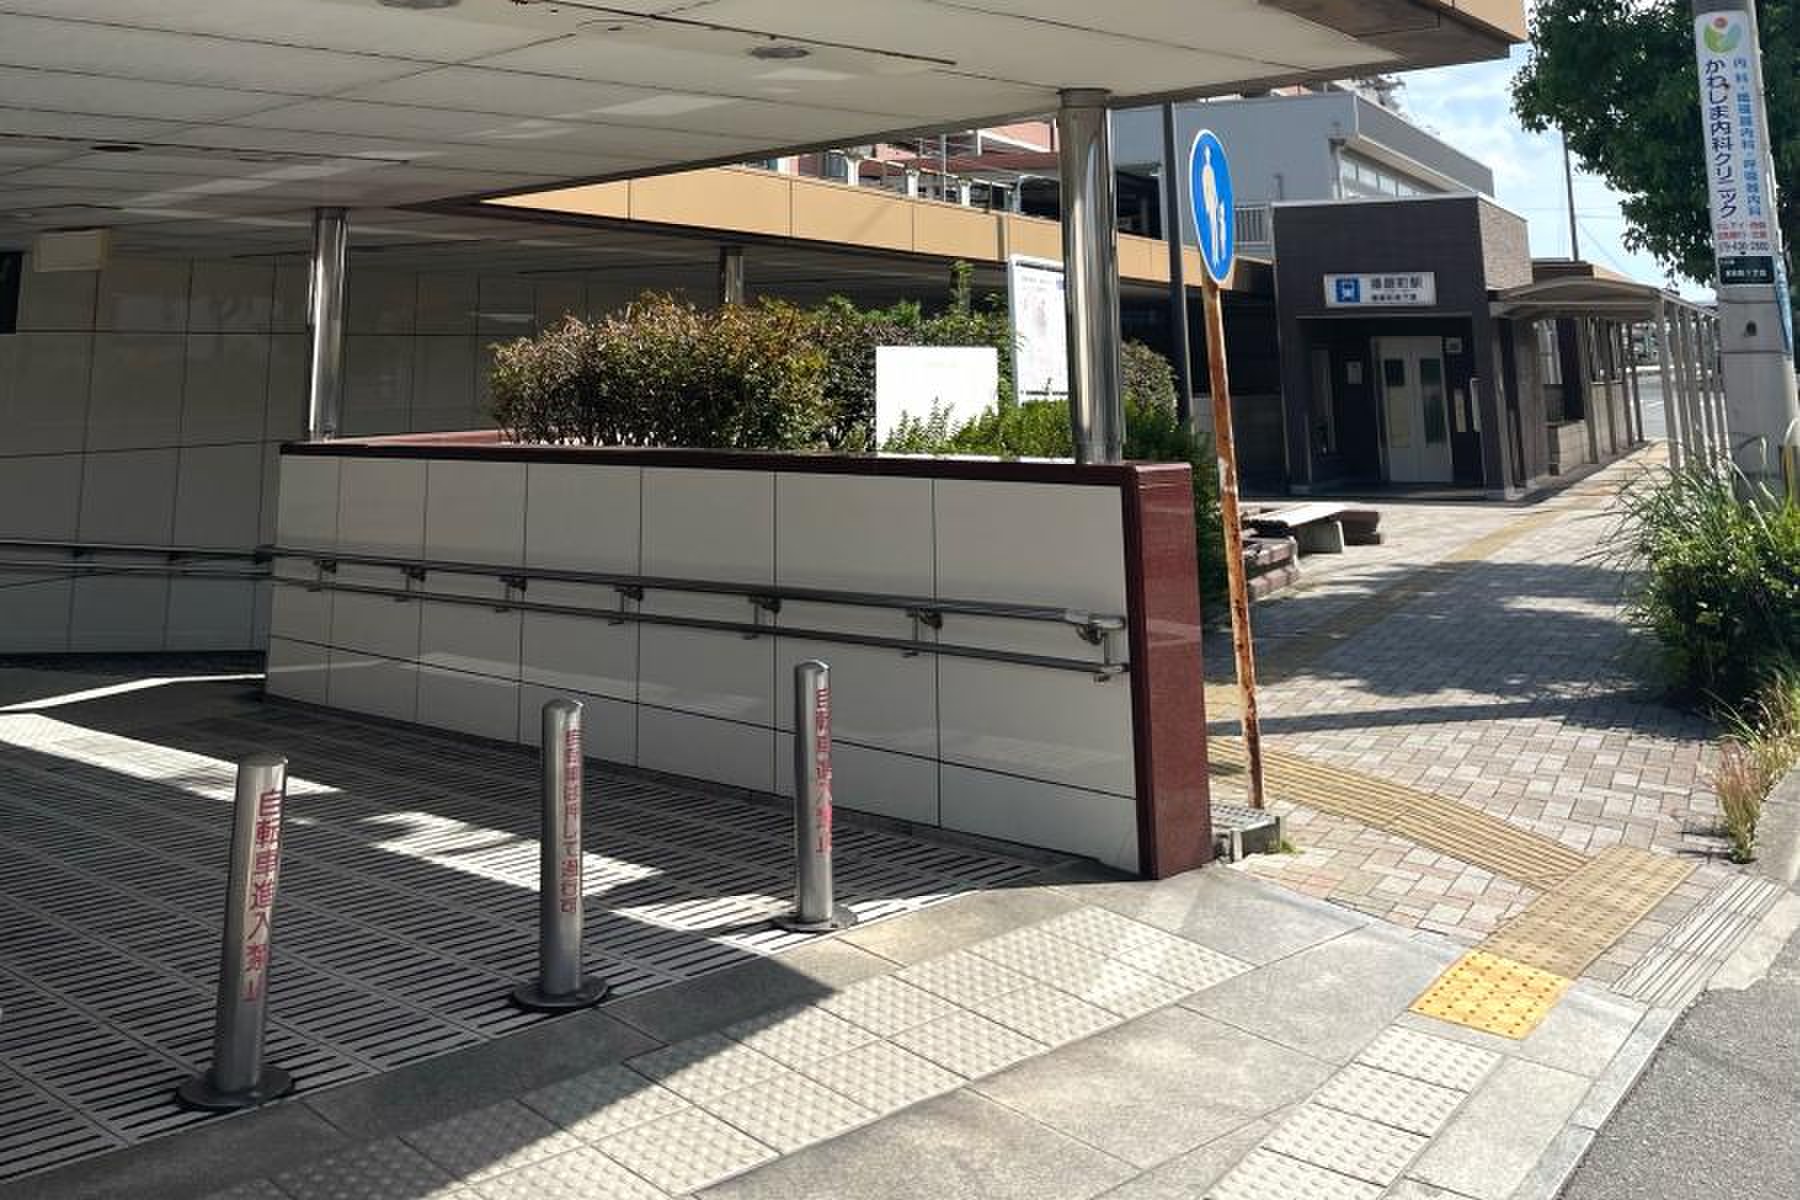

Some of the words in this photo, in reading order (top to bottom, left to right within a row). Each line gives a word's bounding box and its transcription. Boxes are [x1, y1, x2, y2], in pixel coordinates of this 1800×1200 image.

[245, 788, 283, 1003] 自転車進入禁止
